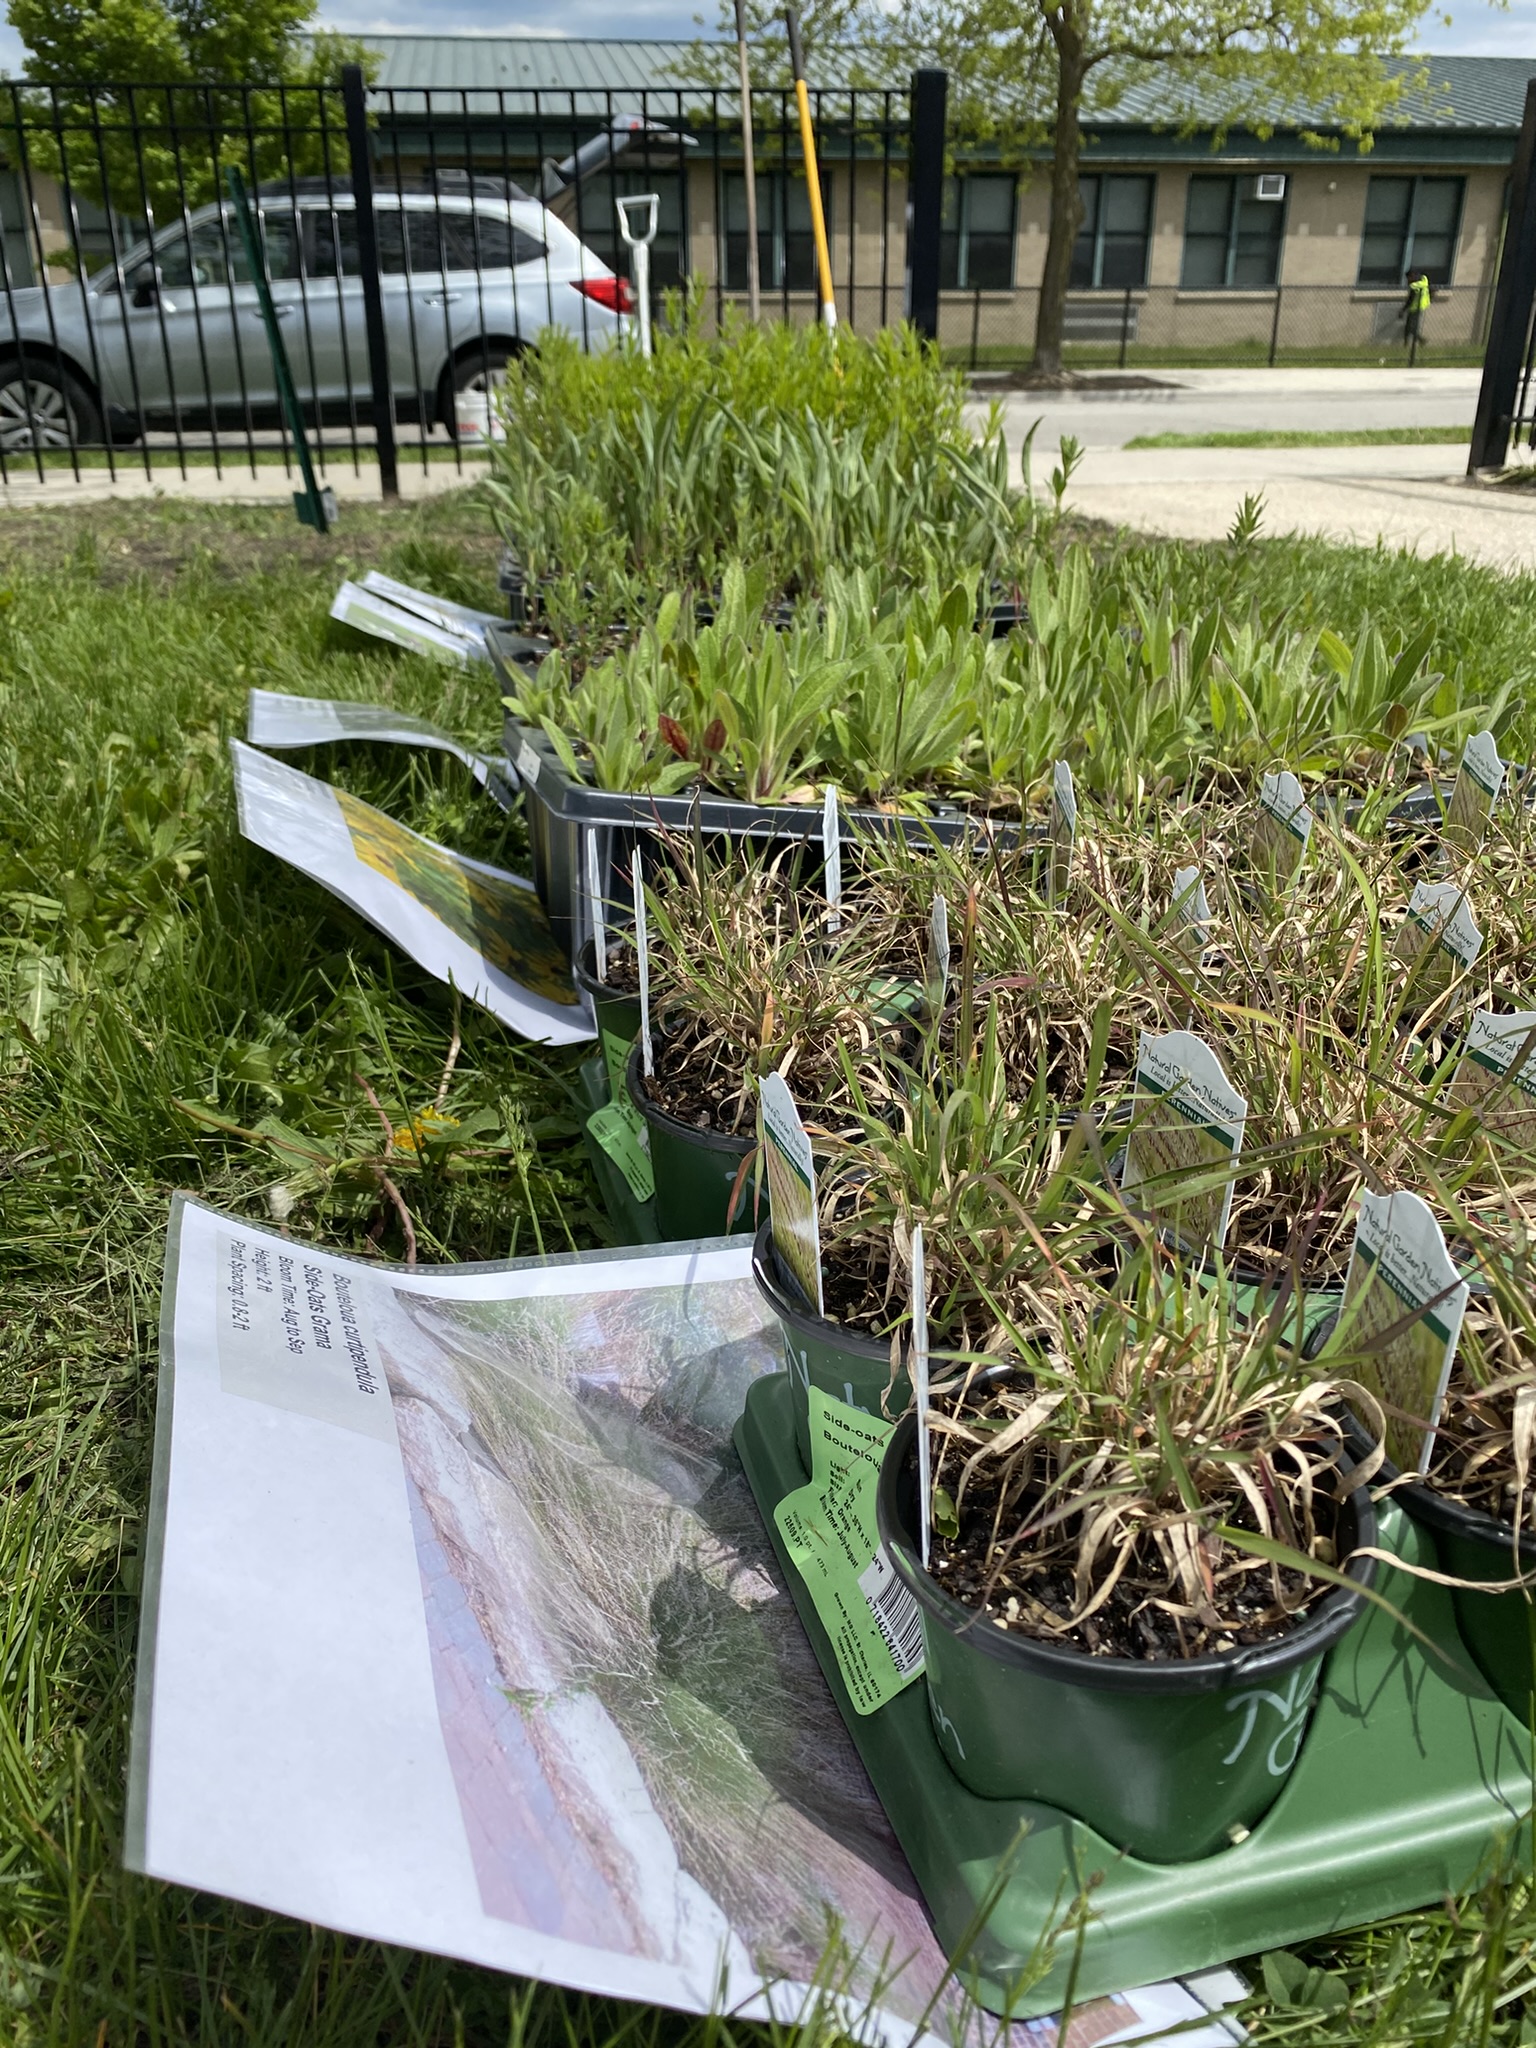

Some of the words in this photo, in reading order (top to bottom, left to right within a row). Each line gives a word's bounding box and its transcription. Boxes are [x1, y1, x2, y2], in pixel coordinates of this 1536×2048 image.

[1475, 1020, 1516, 1051] Natural
[1150, 1065, 1166, 1082] Local
[1202, 1085, 1237, 1119] Natives
[230, 1239, 246, 1261] Plant
[252, 1247, 271, 1276] Height:
[227, 1260, 248, 1298] Spacing:
[257, 1277, 272, 1285] 2
[279, 1255, 294, 1282] Bloom
[257, 1284, 273, 1293] ft
[281, 1283, 297, 1307] Time:
[304, 1264, 327, 1313] Side-Oats
[333, 1273, 356, 1324] Bouteloua
[232, 1299, 249, 1322] 0.8-2
[281, 1306, 300, 1325] Aug
[233, 1322, 250, 1331] ft
[287, 1327, 302, 1336] to
[311, 1315, 332, 1350] Grama
[285, 1337, 306, 1355] Sep
[343, 1325, 379, 1395] curtipendula
[837, 1507, 850, 1532] Orange
[824, 1508, 839, 1530] Time:
[837, 1531, 859, 1569] July-August
[865, 1596, 874, 1606] 0
[869, 1603, 890, 1640] 718422
[885, 1637, 905, 1672] 841700
